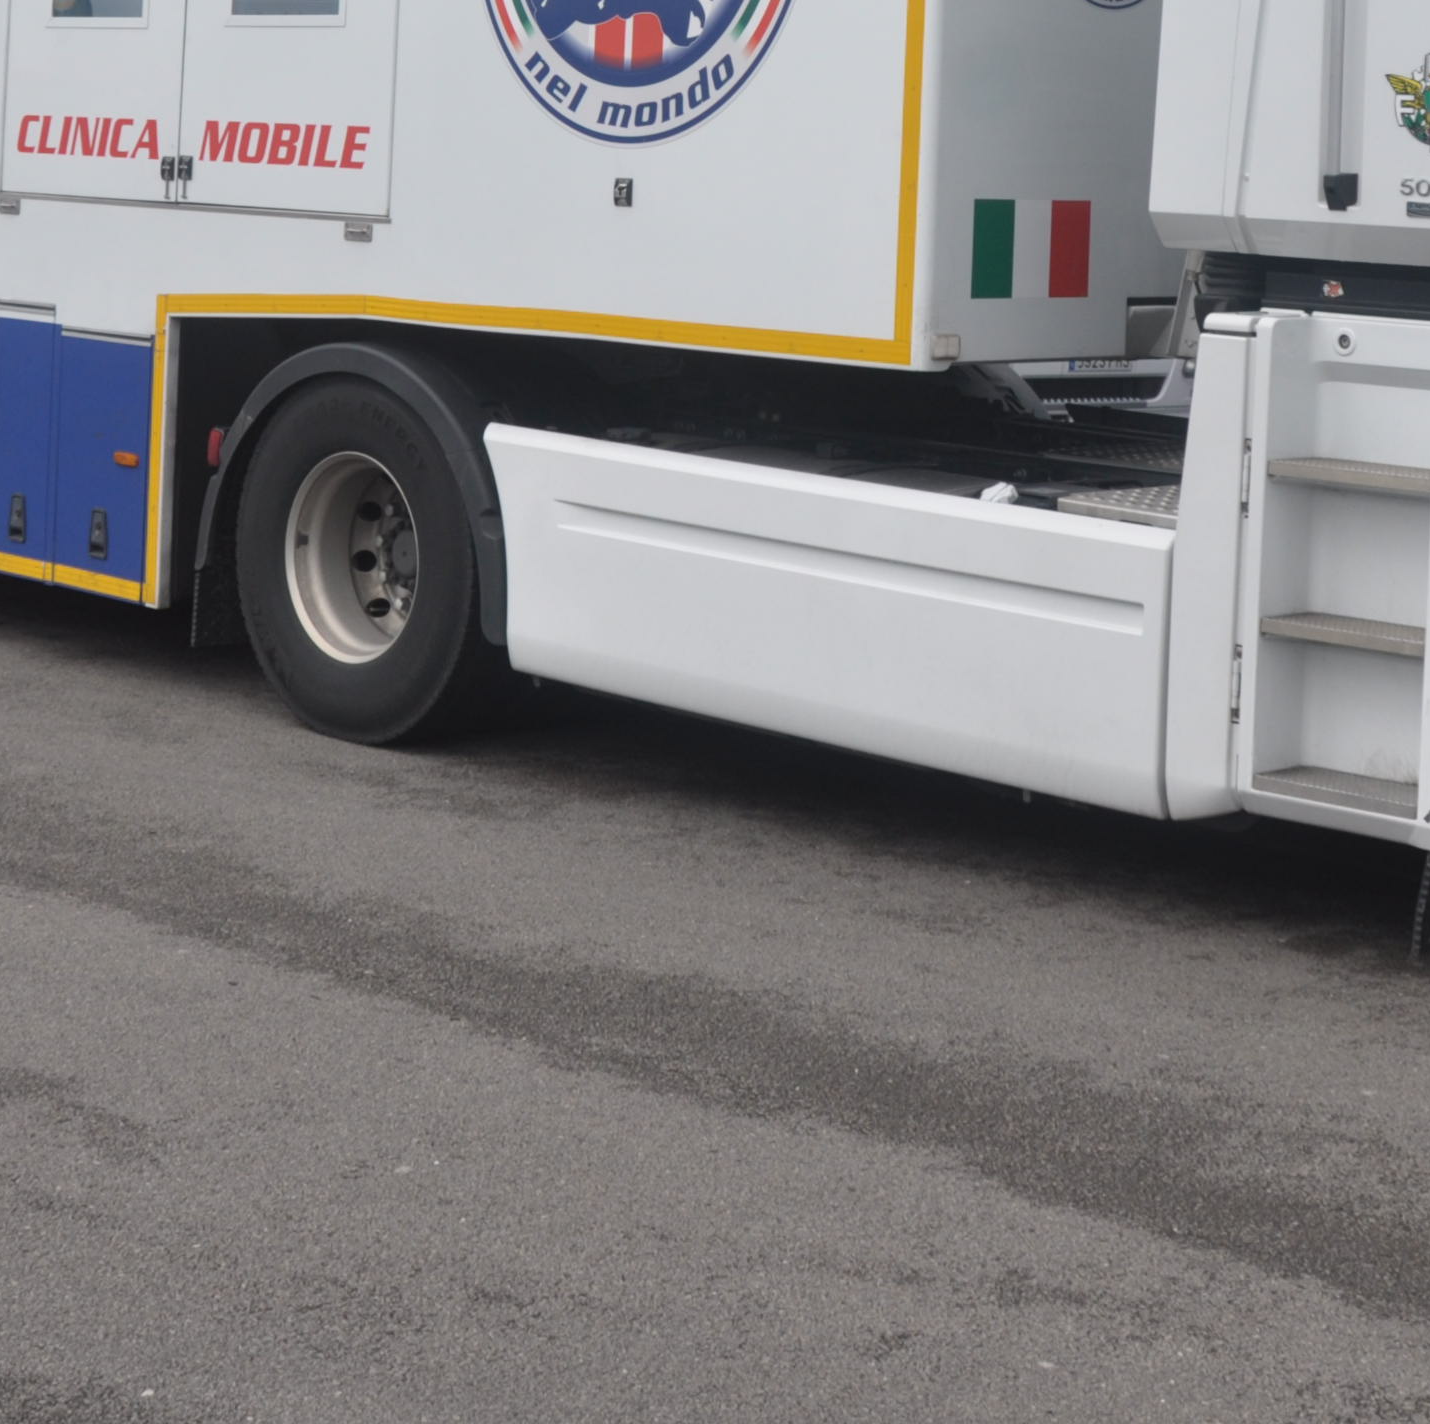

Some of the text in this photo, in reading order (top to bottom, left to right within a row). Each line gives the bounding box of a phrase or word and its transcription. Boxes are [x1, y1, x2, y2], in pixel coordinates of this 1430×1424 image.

[523, 49, 736, 130] nel mondo
[17, 115, 370, 170] CLINICA MOBILE
